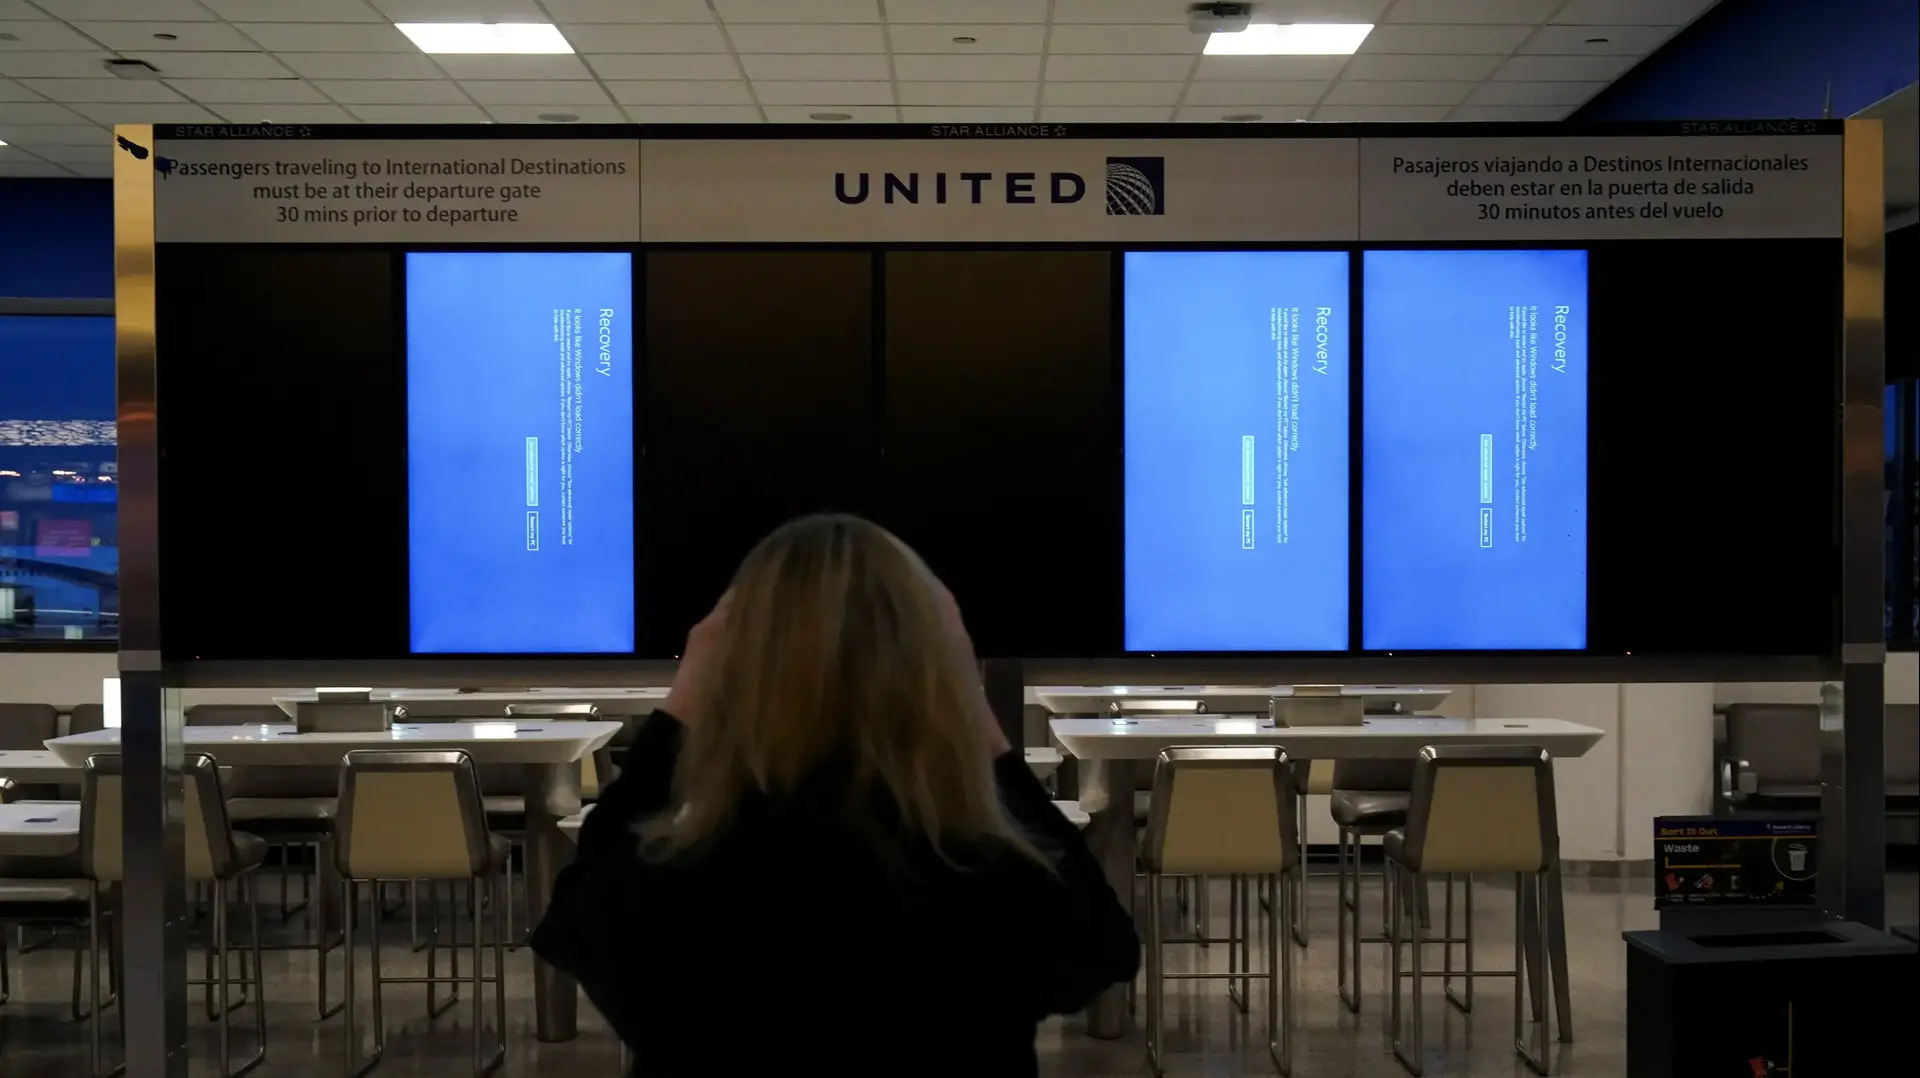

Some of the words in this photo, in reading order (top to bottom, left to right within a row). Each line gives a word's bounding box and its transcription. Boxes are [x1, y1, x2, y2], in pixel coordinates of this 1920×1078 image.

[175, 125, 213, 137] STAR
[219, 125, 294, 137] ALLIANCE
[931, 125, 970, 137] STAR
[974, 125, 1049, 137] ALLIANCE
[1681, 122, 1719, 134] STAR
[1725, 121, 1799, 134] ALLIANCE
[167, 158, 270, 180] Passengers
[275, 158, 356, 179] traveling
[362, 161, 381, 175] to
[386, 157, 504, 175] International
[511, 157, 626, 175] Destinations
[1393, 157, 1479, 177] Pasajeros
[1483, 155, 1563, 177] viajando
[1567, 160, 1579, 173] a
[1583, 155, 1664, 173] Destinos
[1668, 153, 1809, 172] Internacionales
[253, 184, 300, 199] must
[304, 181, 327, 199] be
[332, 184, 350, 199] at
[355, 181, 398, 199] their
[402, 181, 494, 203] departure
[499, 184, 541, 203] gate
[834, 172, 1087, 205] UNITED
[1446, 179, 1505, 197] deben
[1510, 181, 1556, 197] estar
[1559, 183, 1583, 196] en
[1588, 178, 1603, 196] la
[1608, 181, 1669, 200] puerta
[1673, 177, 1697, 196] de
[1701, 177, 1754, 195] salida
[277, 206, 300, 222] 30
[304, 205, 349, 222] mins
[353, 205, 398, 226] prior
[402, 207, 421, 222] to
[426, 204, 518, 226] departure
[1477, 203, 1500, 220] 30
[1505, 203, 1581, 220] minutos
[1585, 204, 1634, 220] antes
[1639, 201, 1668, 219] del
[1672, 201, 1725, 219] vuelo
[574, 315, 583, 334] looks
[1530, 312, 1538, 330] looks
[595, 308, 615, 376] Recovery
[1312, 307, 1331, 375] Recovery
[1530, 332, 1538, 344] like
[1551, 306, 1570, 373] Recovery
[574, 349, 583, 381] Windows
[1292, 348, 1300, 380] Windows
[1530, 346, 1538, 378] Windows
[574, 383, 583, 403] didn't
[1292, 381, 1300, 402] didn't
[1530, 380, 1538, 400] didn't
[574, 405, 583, 421] load
[1292, 403, 1300, 419] load
[1530, 402, 1538, 418] load
[573, 421, 583, 453] correctly
[1290, 420, 1299, 451] correctly
[1528, 419, 1538, 450] correctly
[1660, 828, 1686, 837] Sort
[1687, 827, 1697, 836] It
[1698, 827, 1718, 835] Out
[1664, 843, 1700, 853] Waste
